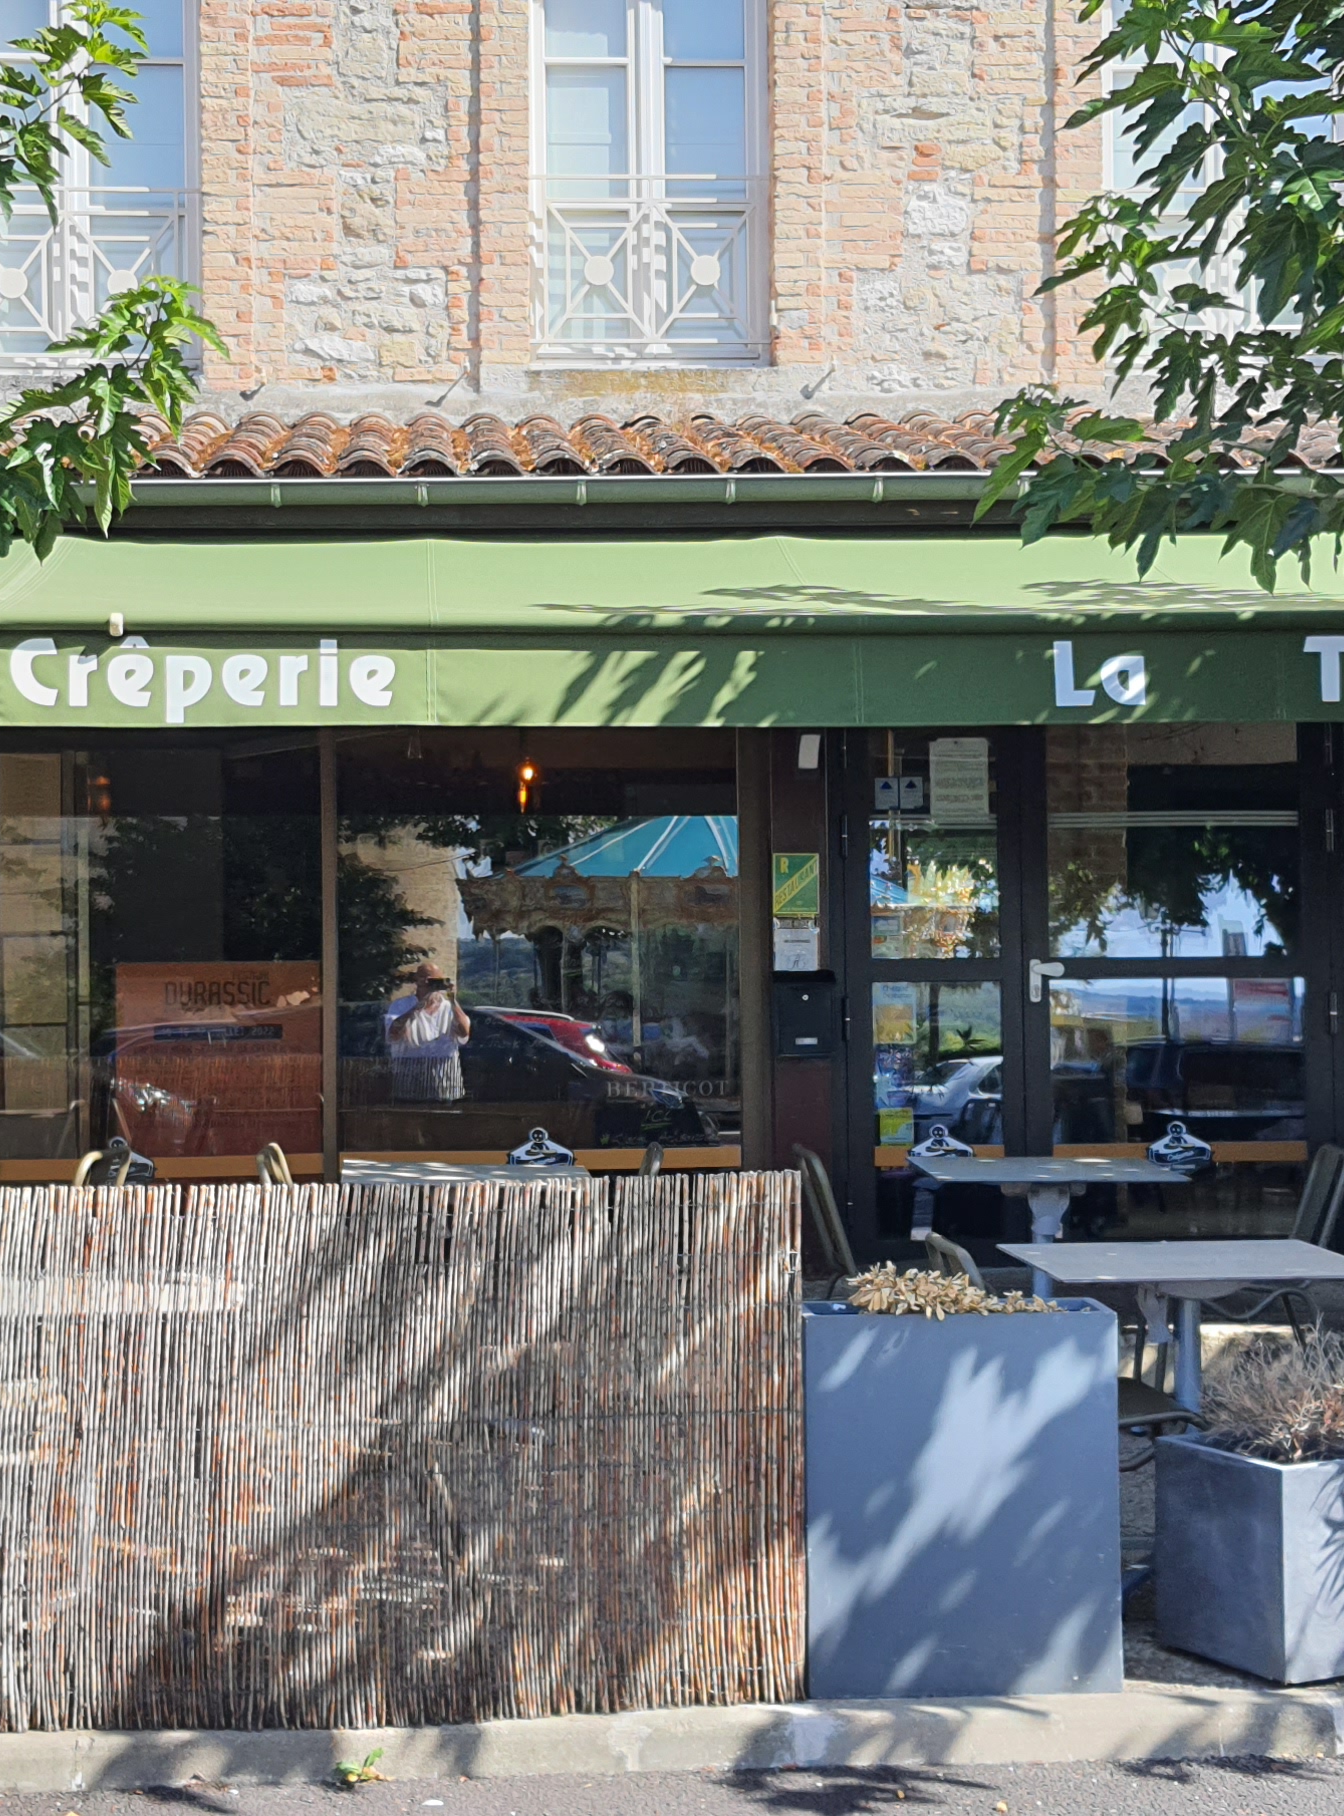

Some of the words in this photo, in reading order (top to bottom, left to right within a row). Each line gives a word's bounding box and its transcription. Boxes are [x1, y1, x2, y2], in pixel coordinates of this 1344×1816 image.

[9, 635, 396, 724] Crêperie
[1052, 640, 1146, 707] La
[164, 980, 271, 1008] DURASSIC
